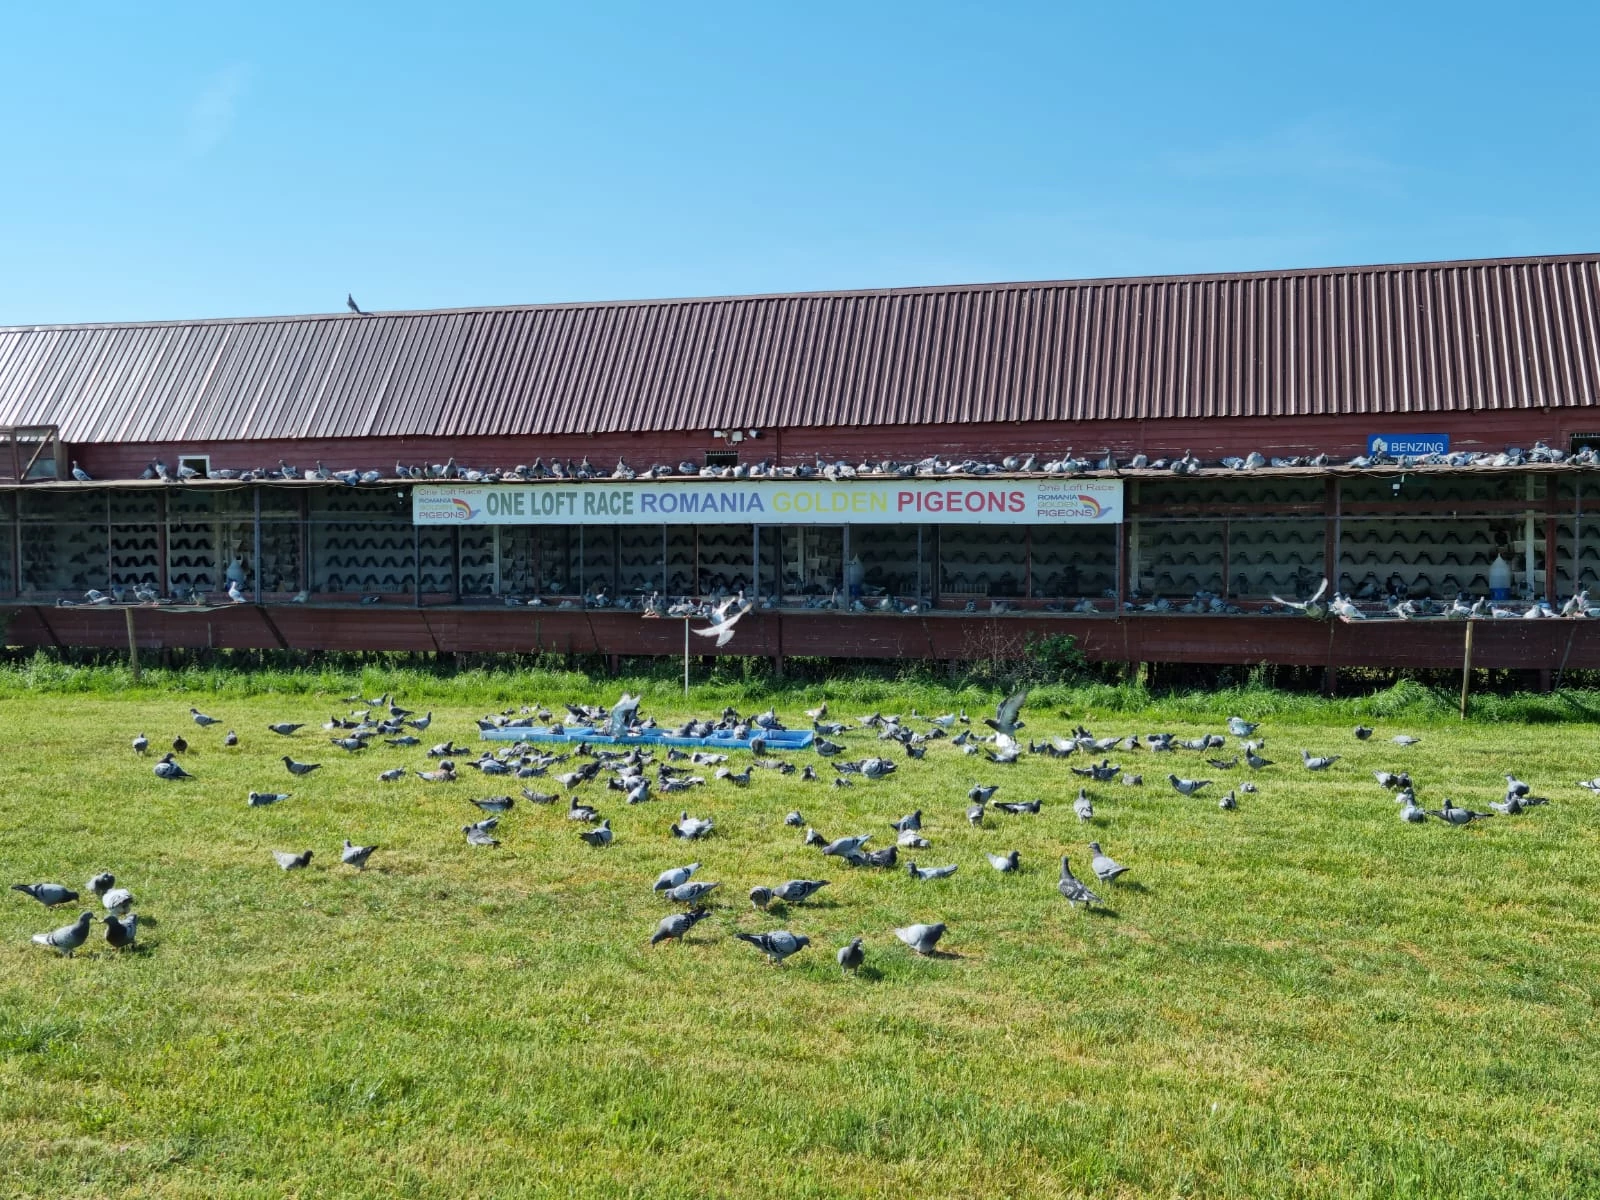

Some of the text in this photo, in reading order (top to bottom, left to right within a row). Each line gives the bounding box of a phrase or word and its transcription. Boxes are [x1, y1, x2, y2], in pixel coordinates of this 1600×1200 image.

[1391, 442, 1444, 452] BENZING
[1038, 483, 1115, 491] One Loft Race
[419, 488, 438, 496] One
[441, 488, 457, 496] Loft
[486, 491, 1026, 516] ONE LOFT RACE ROMANIA GOLDEN PIGEONS
[418, 511, 465, 519] PIGEONS
[1037, 509, 1093, 517] PIGEONS
